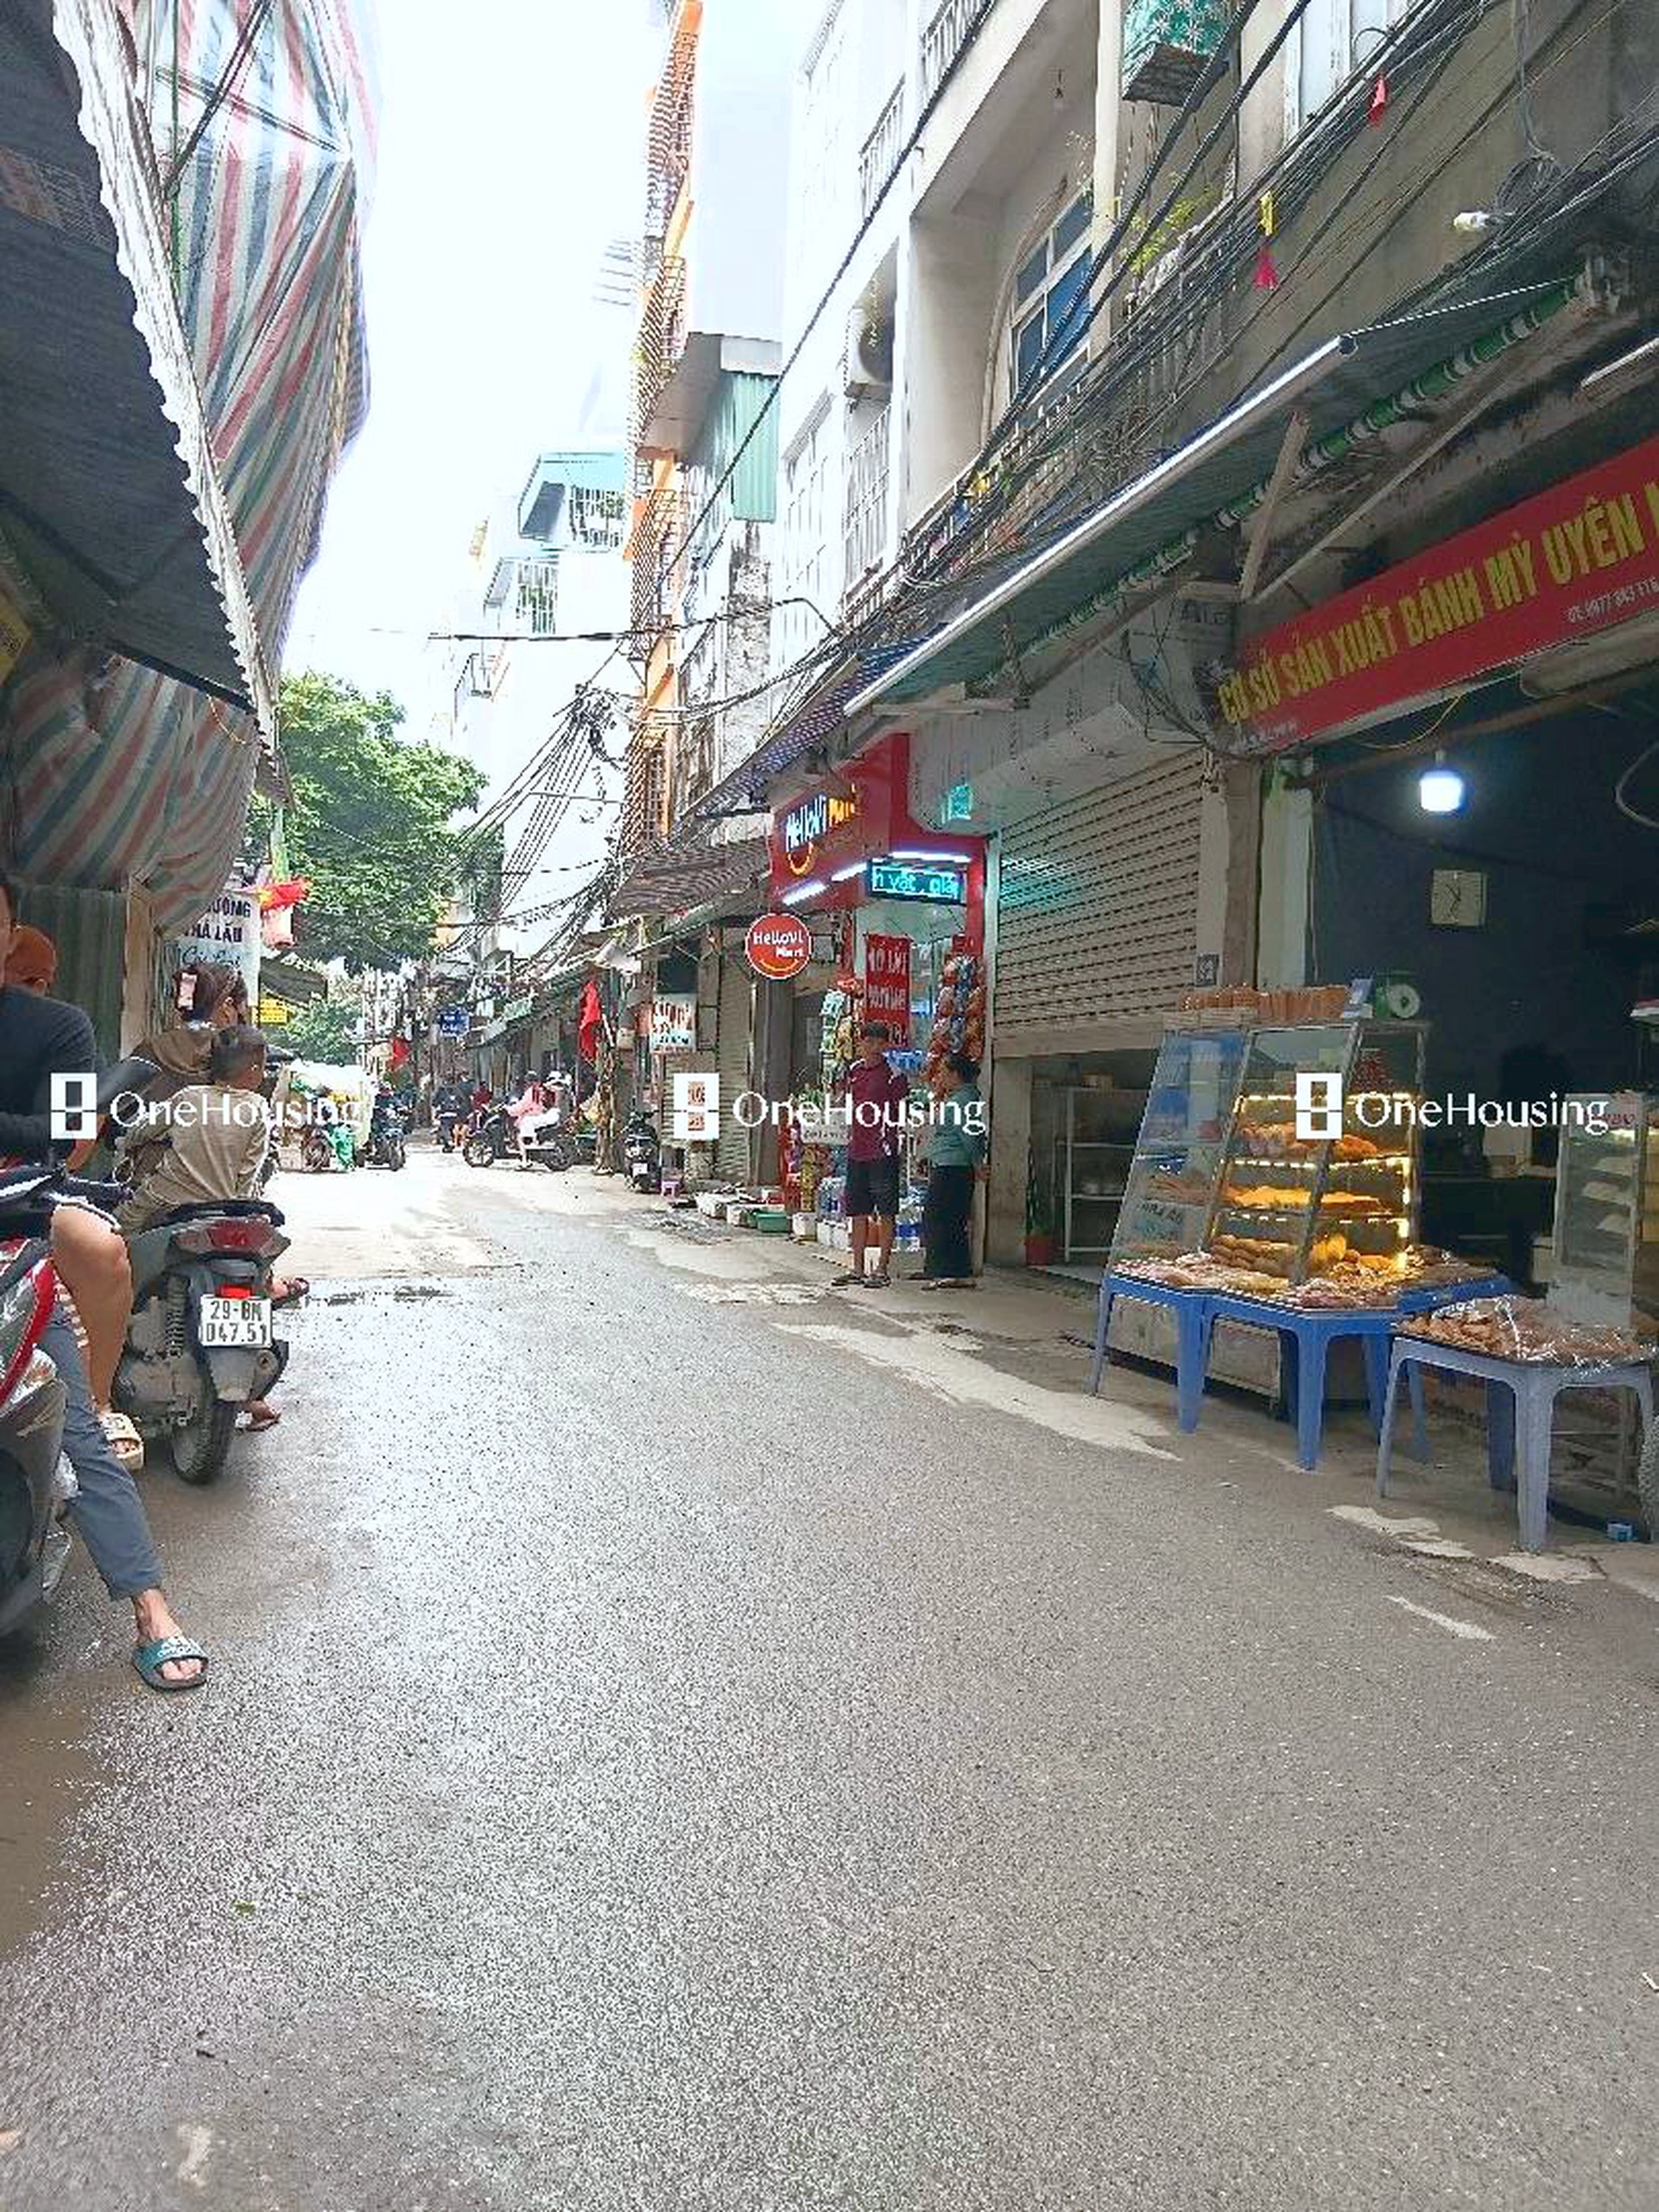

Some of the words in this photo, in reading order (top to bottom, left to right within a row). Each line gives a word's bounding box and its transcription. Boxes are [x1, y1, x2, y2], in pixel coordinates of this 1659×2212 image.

[1331, 593, 1397, 677] XUẤT
[1398, 566, 1484, 647] BÁNH
[1542, 496, 1645, 585] UYÊN
